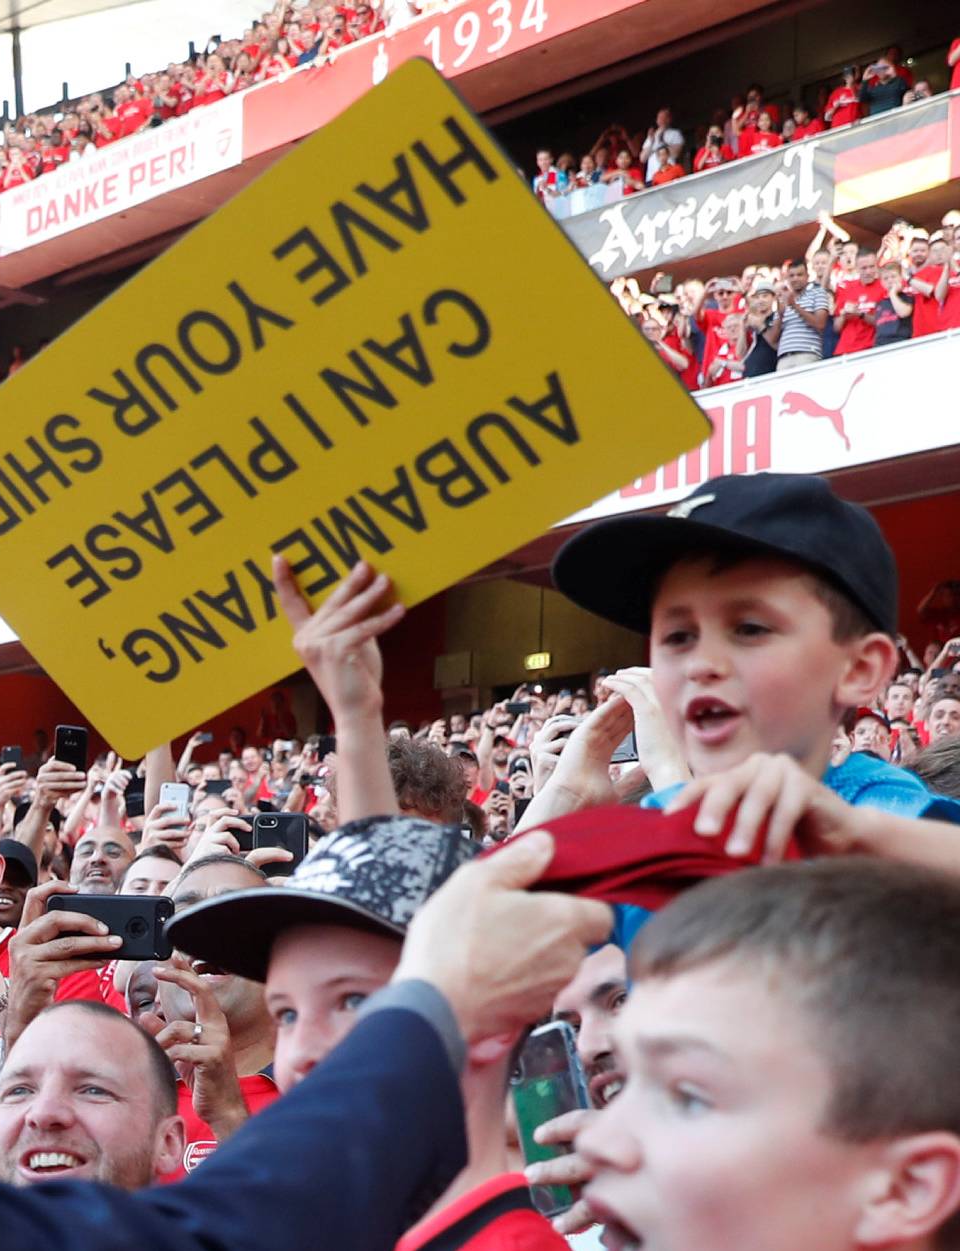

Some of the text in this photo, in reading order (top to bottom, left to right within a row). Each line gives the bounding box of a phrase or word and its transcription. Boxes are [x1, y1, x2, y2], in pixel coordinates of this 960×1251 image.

[424, 0, 548, 71] 1934
[26, 174, 119, 236] DANKE
[129, 142, 196, 196] PER!
[271, 115, 500, 308] HAVE
[589, 140, 823, 272] Arsenal
[86, 280, 296, 438] YOUR
[45, 288, 492, 609] CAN I PLEASE
[97, 370, 581, 684] AUBAMEYANG,
